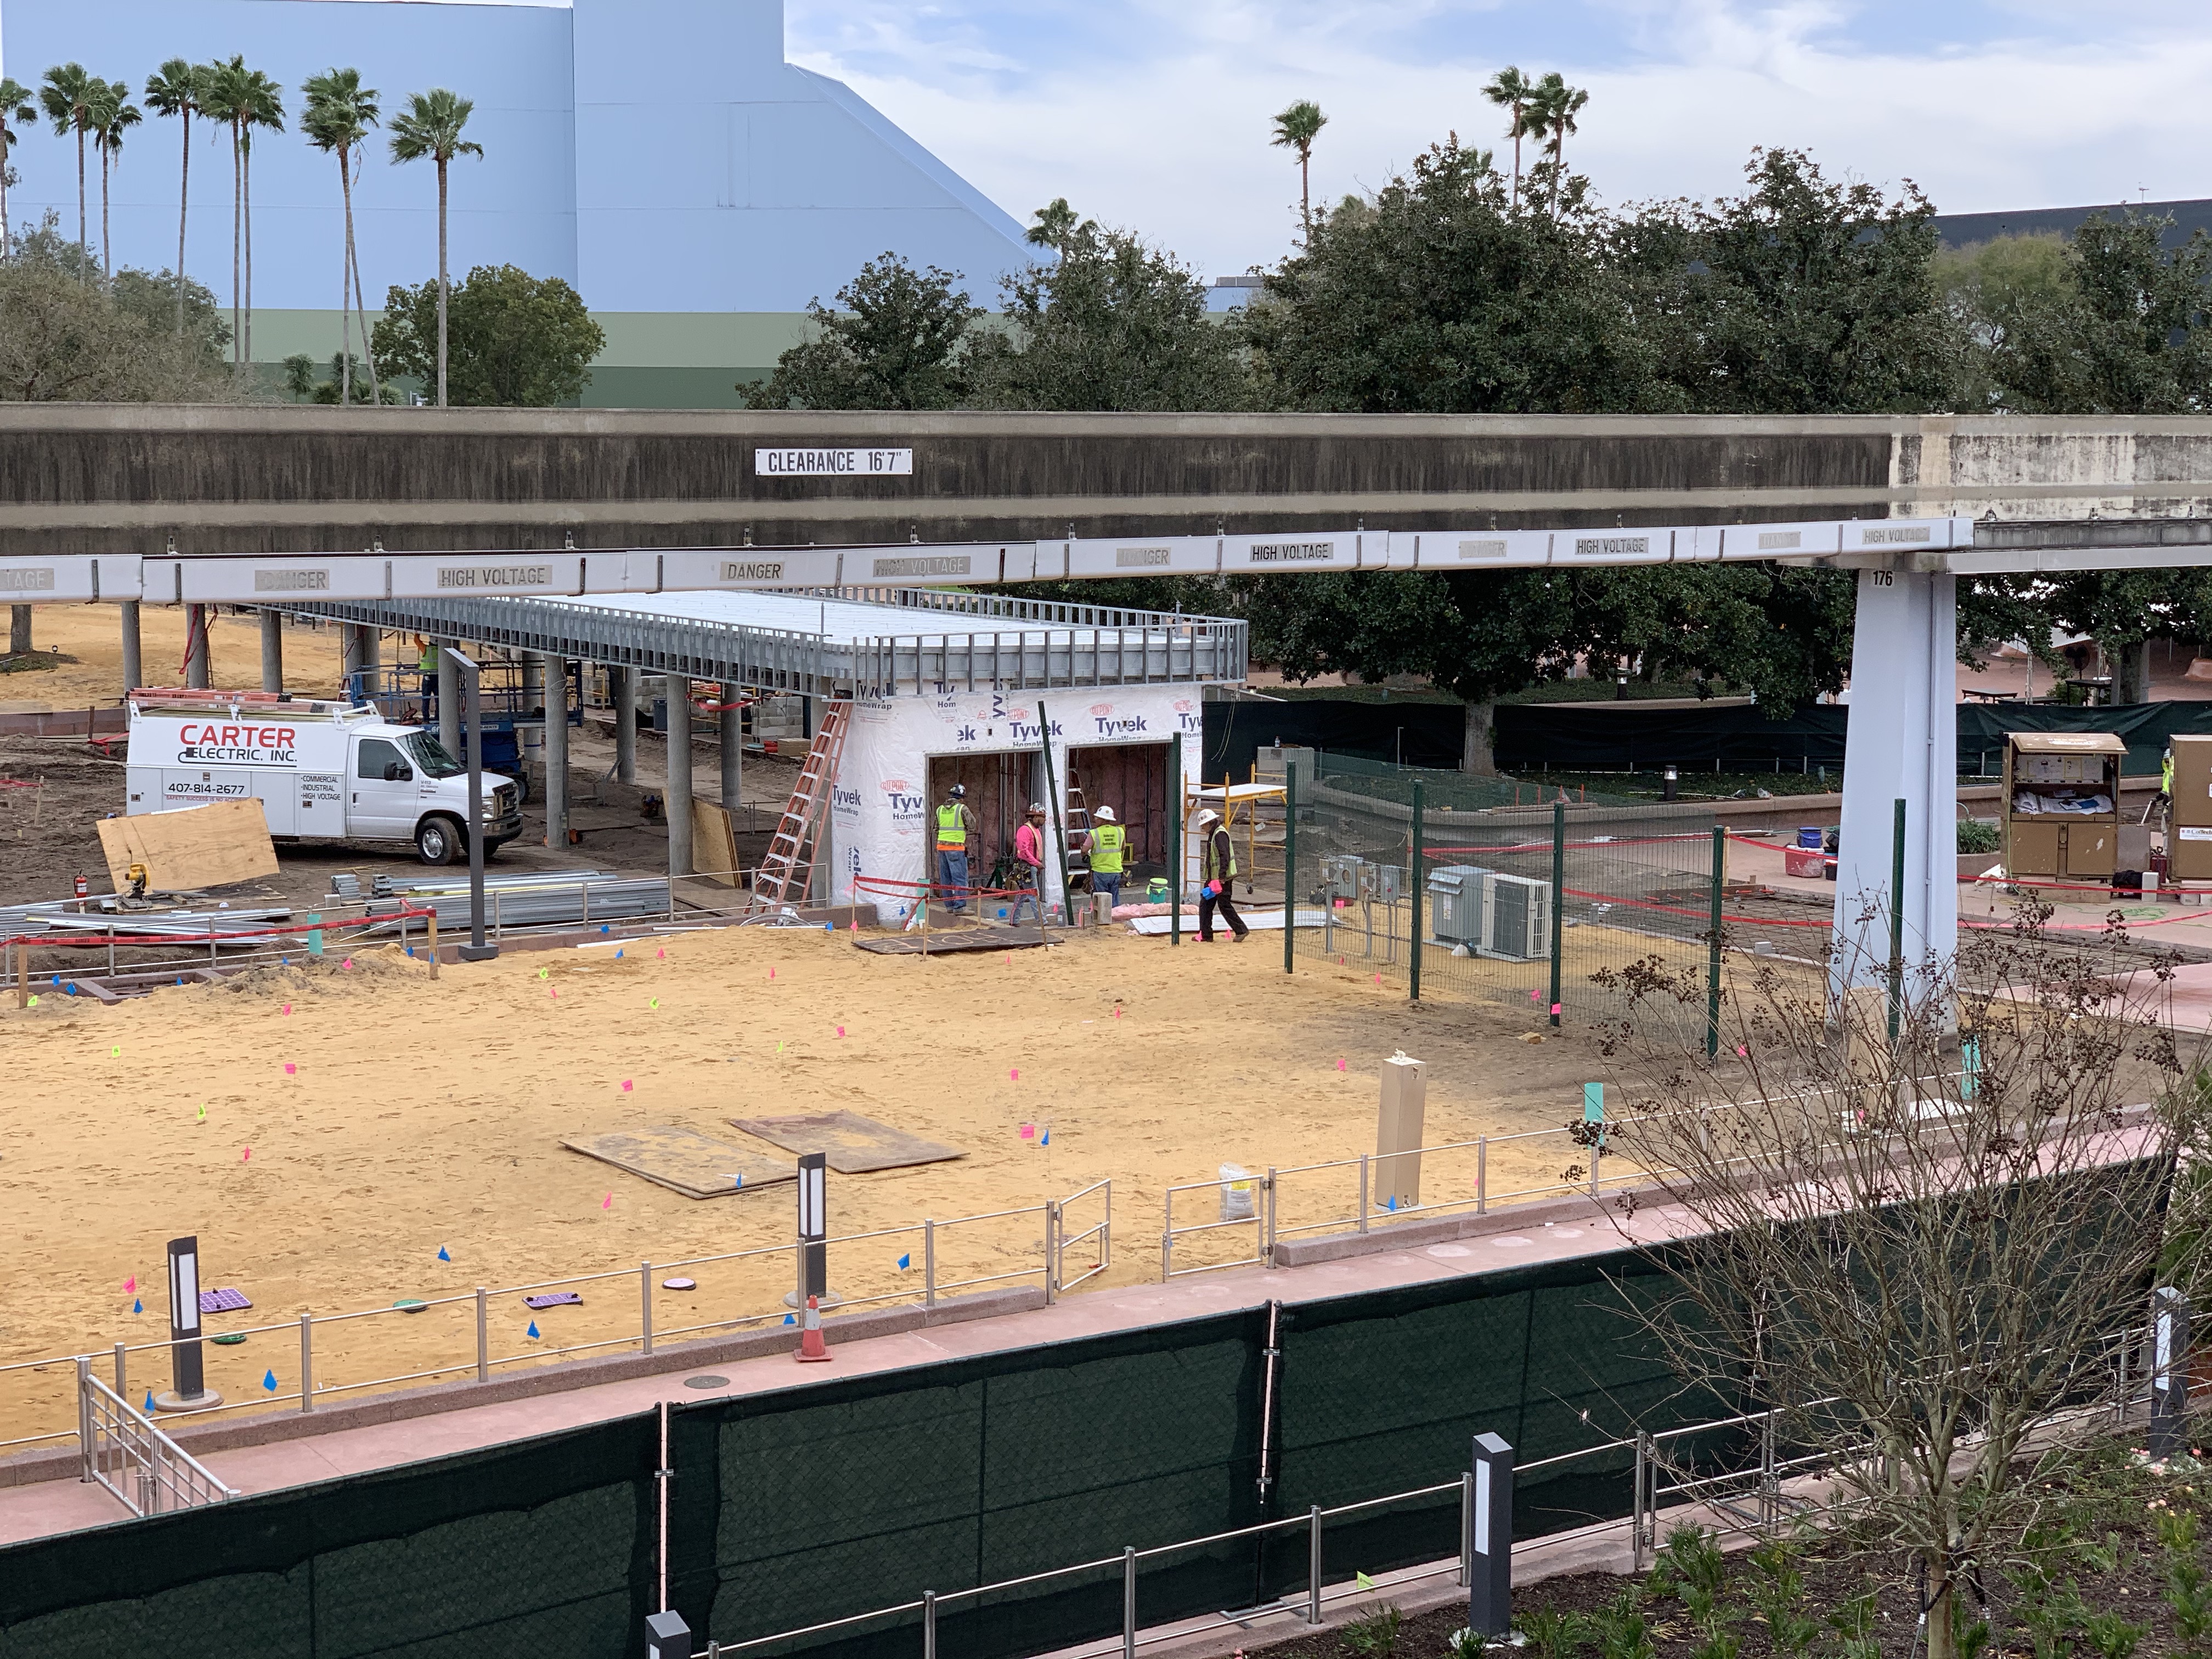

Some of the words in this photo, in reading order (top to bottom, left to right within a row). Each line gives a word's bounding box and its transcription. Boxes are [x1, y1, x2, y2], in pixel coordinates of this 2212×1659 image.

[769, 452, 855, 472] CLEARANCE
[1865, 530, 1885, 543] HIGH
[1252, 546, 1277, 561] HIGH
[1283, 544, 1328, 559] VOLTAGE
[1577, 540, 1599, 554] HIGH
[1603, 539, 1645, 553] VOLTAGE
[728, 564, 781, 579] DANGER
[911, 558, 964, 573] VOLTAGE
[442, 569, 475, 586] HIGH
[483, 568, 545, 585] VOLTAGE
[1873, 570, 1893, 586] 176
[1009, 709, 1028, 719] UPONT
[1095, 715, 1148, 736] Tyvek
[180, 725, 295, 748] CARTER
[193, 747, 263, 761] ELECTRIC,
[270, 750, 297, 761] INC.
[168, 783, 245, 794] 407-814-2677
[833, 785, 861, 806] Tyvek
[833, 804, 859, 816] HomeWrap
[888, 793, 923, 814] Tyv
